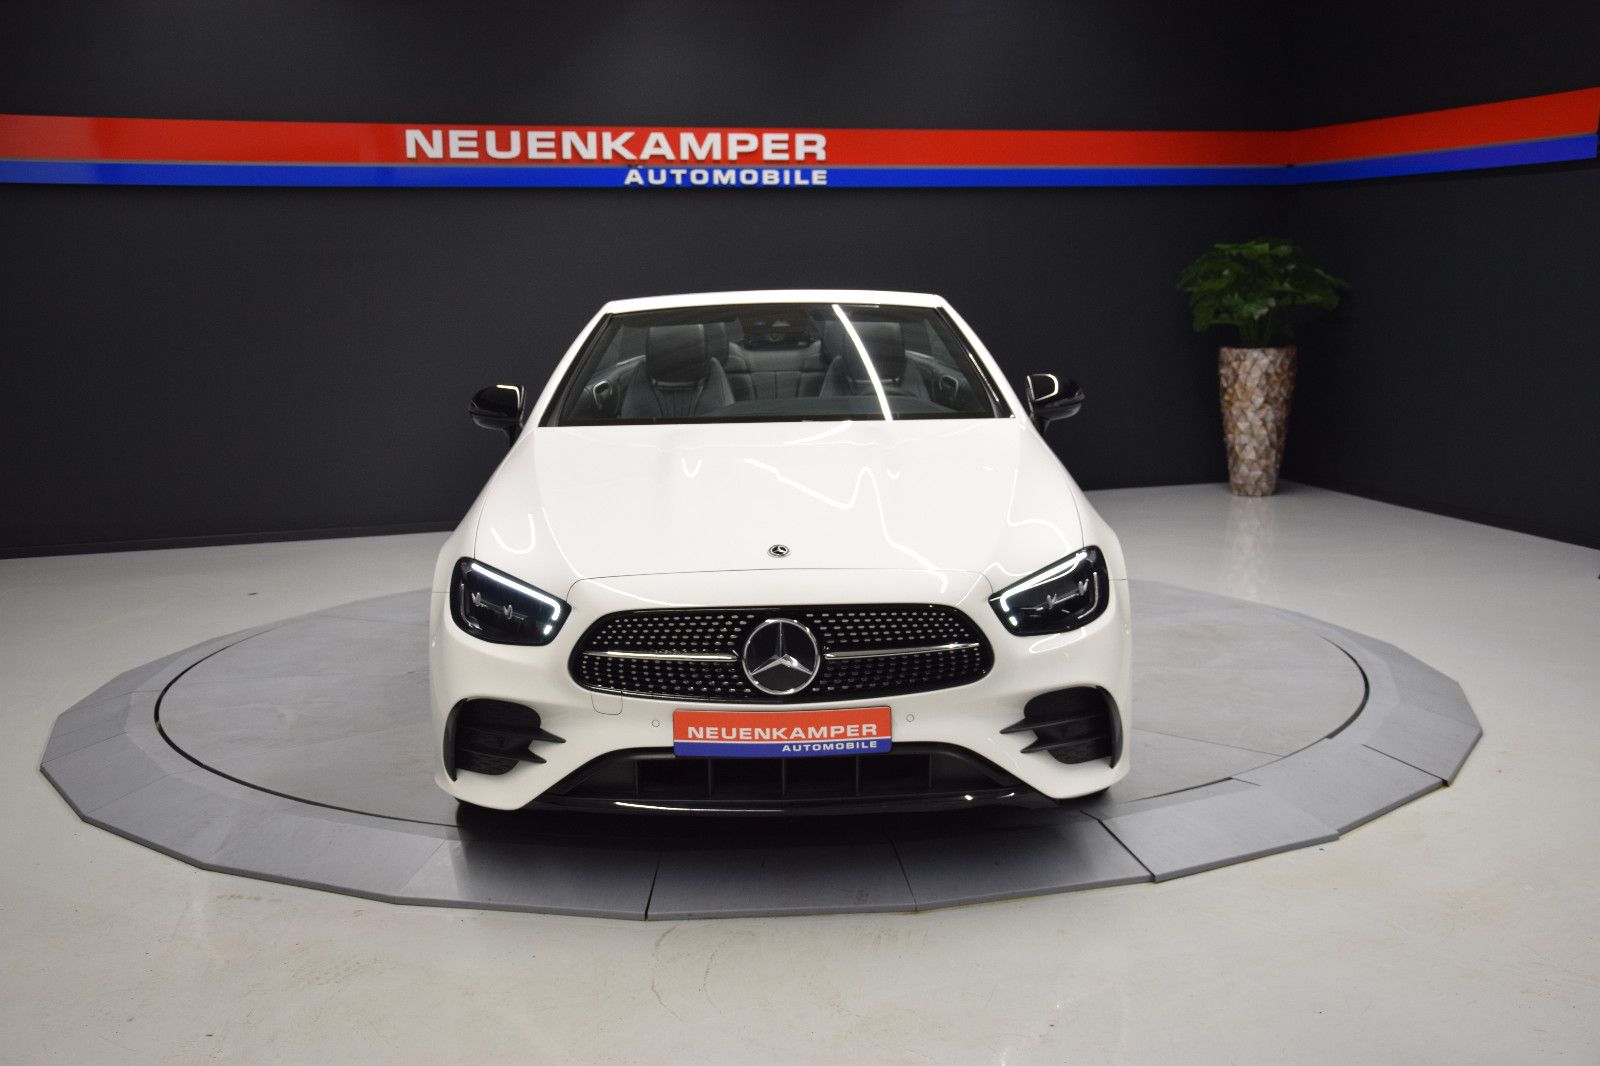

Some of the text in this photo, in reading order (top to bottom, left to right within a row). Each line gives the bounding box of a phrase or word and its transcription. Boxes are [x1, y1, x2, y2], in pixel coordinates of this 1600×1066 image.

[404, 129, 827, 161] NEUENKAMPER
[624, 168, 828, 186] AUTOMOBILE
[687, 723, 877, 740] NEUENKAMPER
[782, 741, 877, 752] AUTOMOBILE
